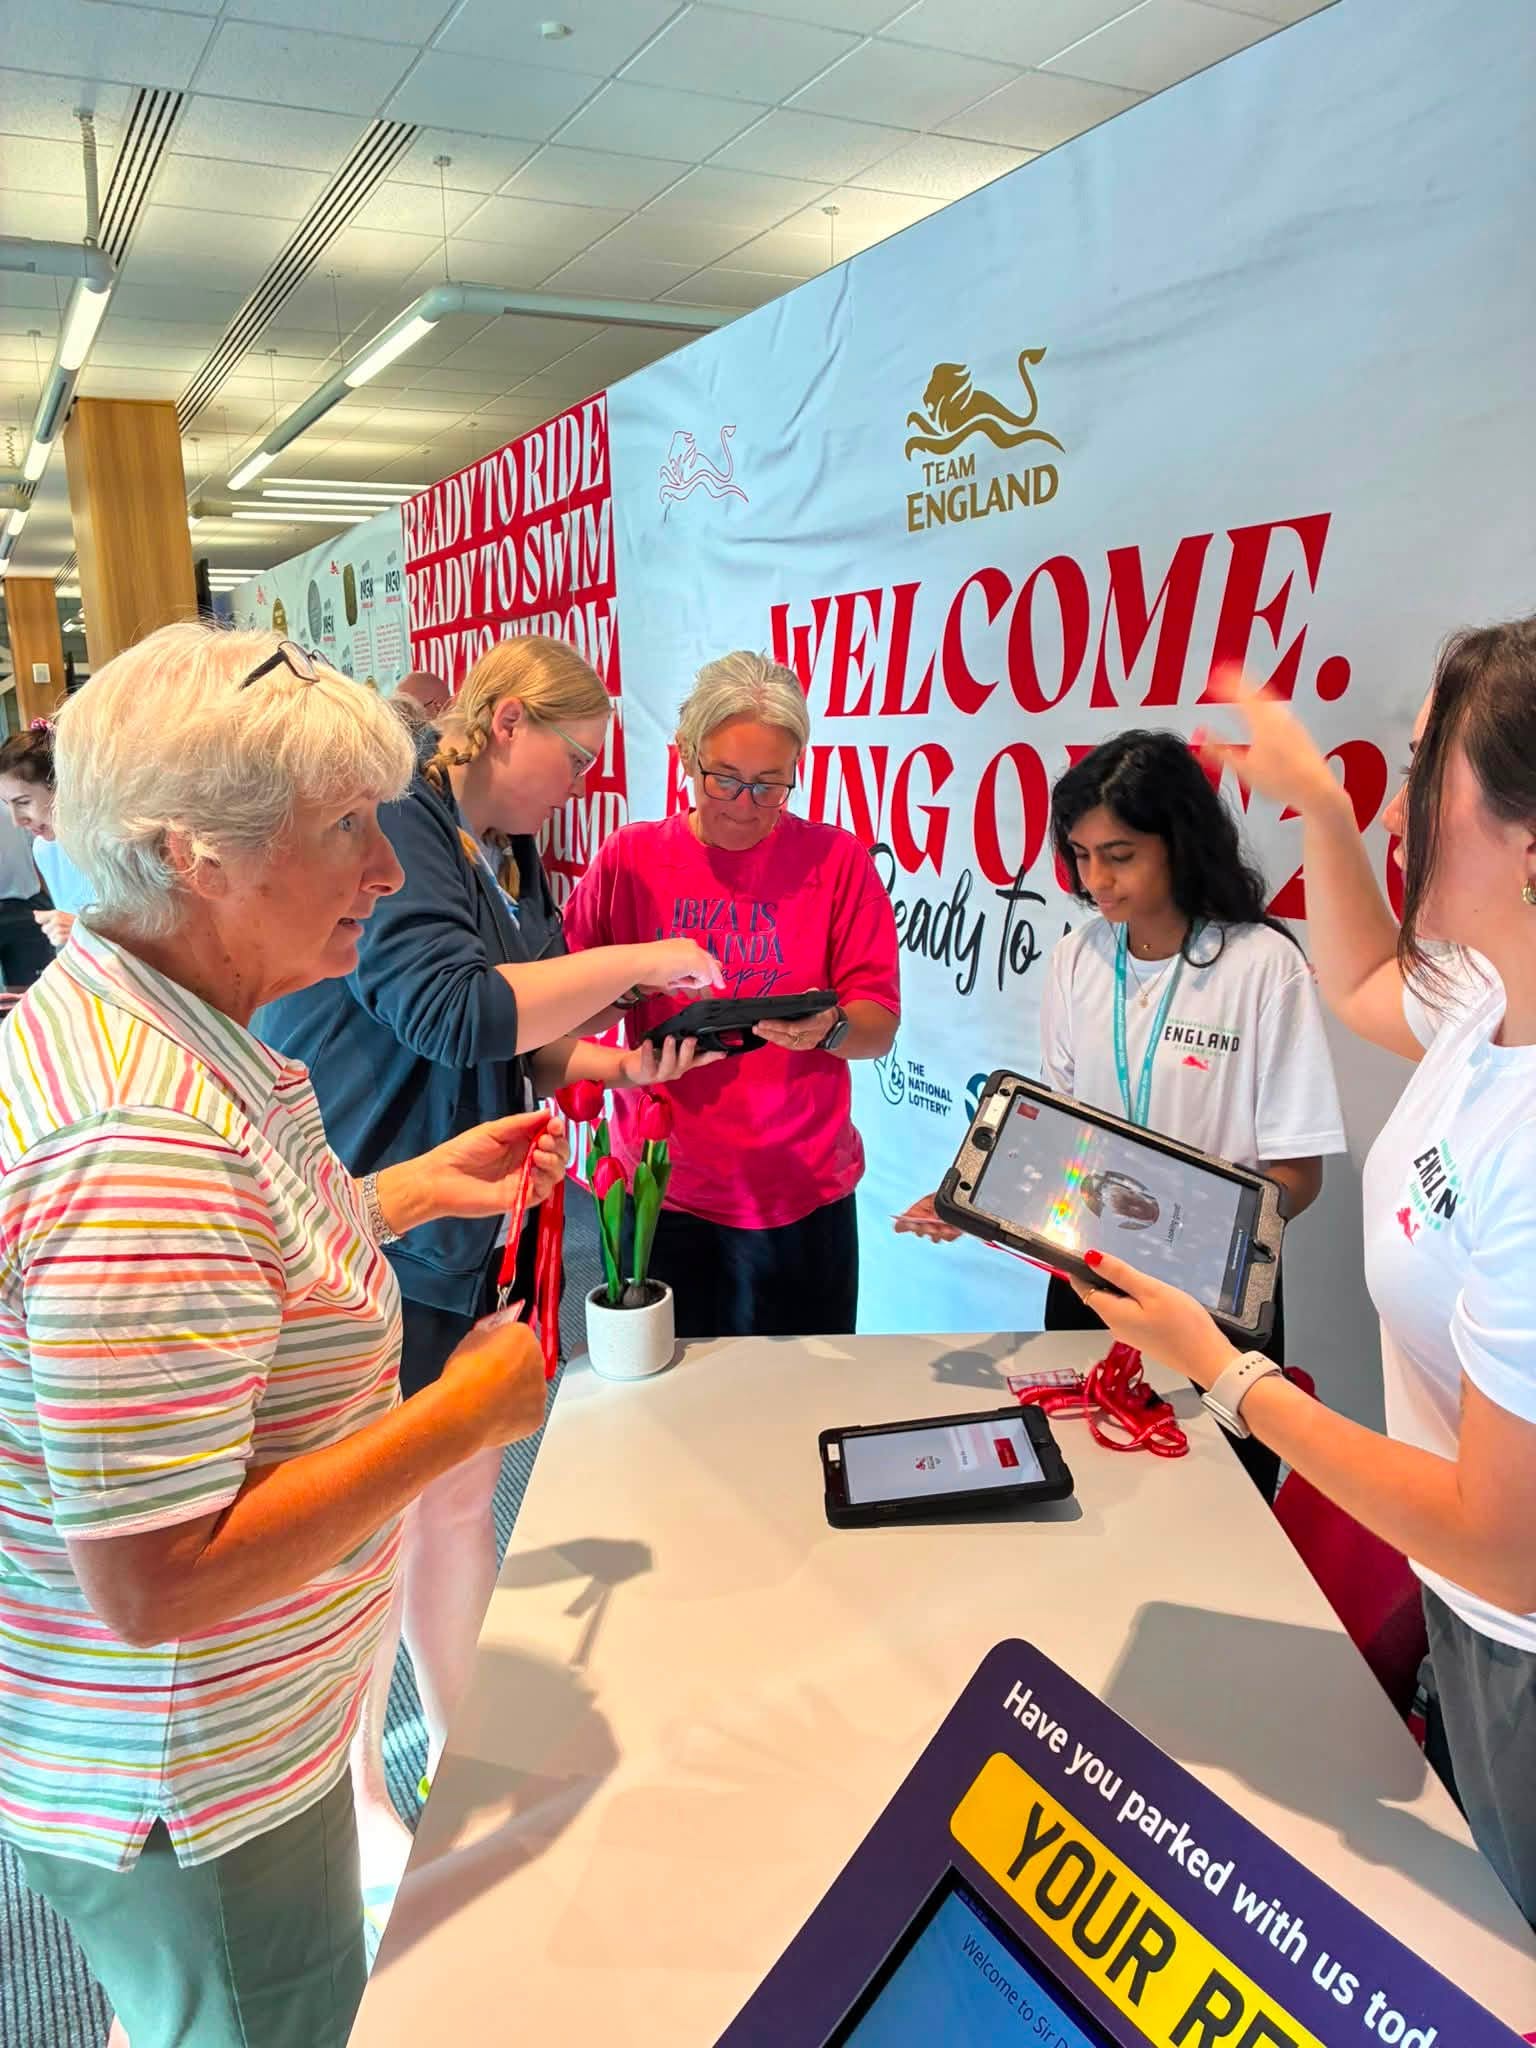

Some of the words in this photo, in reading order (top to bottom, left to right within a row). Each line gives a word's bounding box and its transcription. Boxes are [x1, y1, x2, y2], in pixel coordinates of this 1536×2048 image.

[402, 467, 478, 563] READY
[480, 447, 518, 533] TO
[522, 396, 607, 517] RIDE
[906, 463, 1060, 533] ENGLAND
[922, 453, 975, 487] TEAM
[406, 549, 476, 632] READY
[479, 534, 518, 615] TO
[523, 496, 611, 604] SWIM
[771, 512, 1352, 718] WELCOME.
[672, 898, 739, 931] IBIZA
[750, 900, 779, 933] IS
[908, 1061, 925, 1077] THE
[1164, 1025, 1241, 1052] ENGLAND
[908, 1077, 953, 1102] NATIONAL
[908, 1091, 948, 1117] LOTTERY
[1002, 1680, 1068, 1755] Have
[1063, 1742, 1123, 1802] you
[1117, 1790, 1236, 1897] parked
[1231, 1883, 1309, 1965] with
[1311, 1952, 1361, 2005] us
[1006, 1802, 1177, 2007] YOUR
[961, 1933, 1019, 2006] Welcome
[1017, 1999, 1034, 2022] to
[1032, 2015, 1056, 2043] Sir
